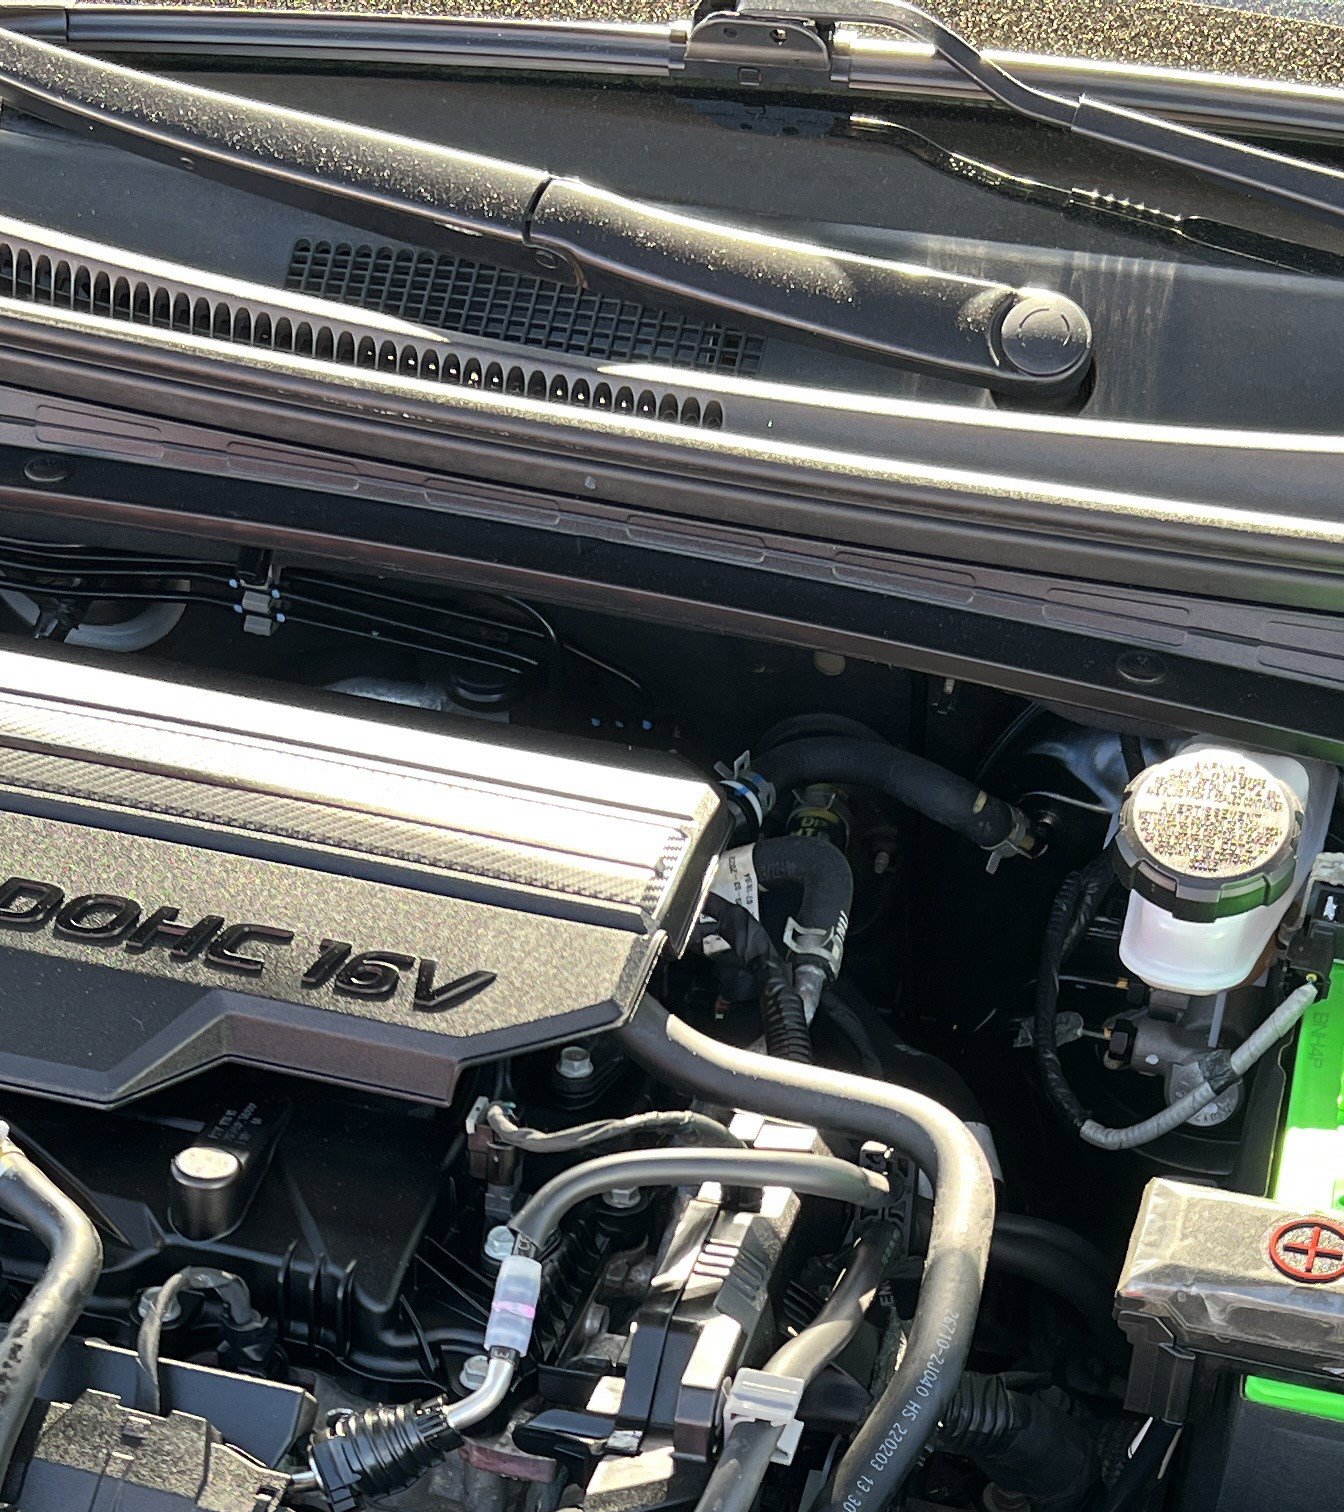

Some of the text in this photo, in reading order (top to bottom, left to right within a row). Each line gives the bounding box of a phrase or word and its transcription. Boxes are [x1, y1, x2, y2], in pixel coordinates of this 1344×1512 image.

[301, 937, 498, 1011] 16V
[901, 1400, 923, 1421] HS
[869, 1422, 908, 1471] 220203
